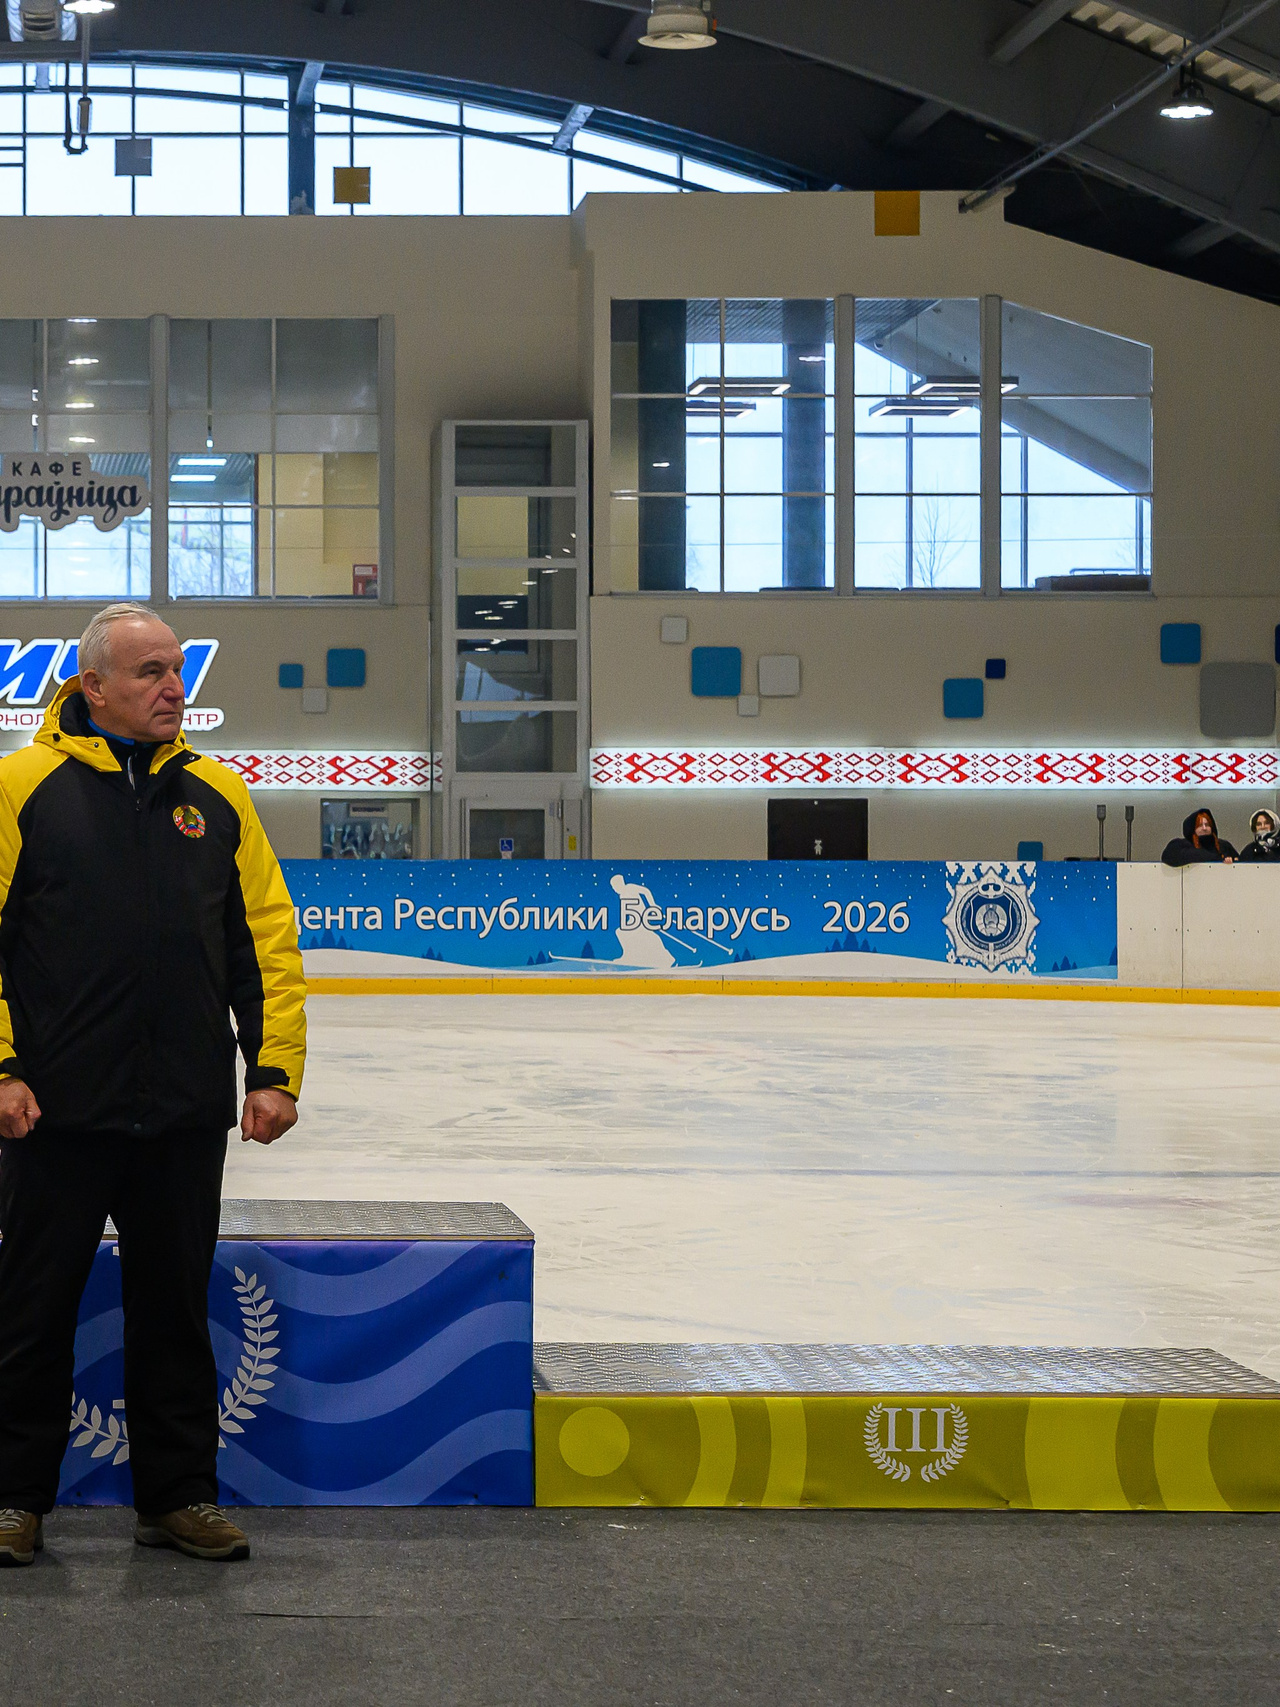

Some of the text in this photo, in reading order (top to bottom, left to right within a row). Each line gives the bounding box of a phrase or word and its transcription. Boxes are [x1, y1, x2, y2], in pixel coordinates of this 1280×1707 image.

[12, 461, 82, 477] КАФЕ
[183, 713, 219, 726] НТР
[394, 897, 608, 939] Республики
[620, 898, 791, 939] Беларусь
[822, 900, 910, 933] 2026
[881, 1407, 952, 1452] III
